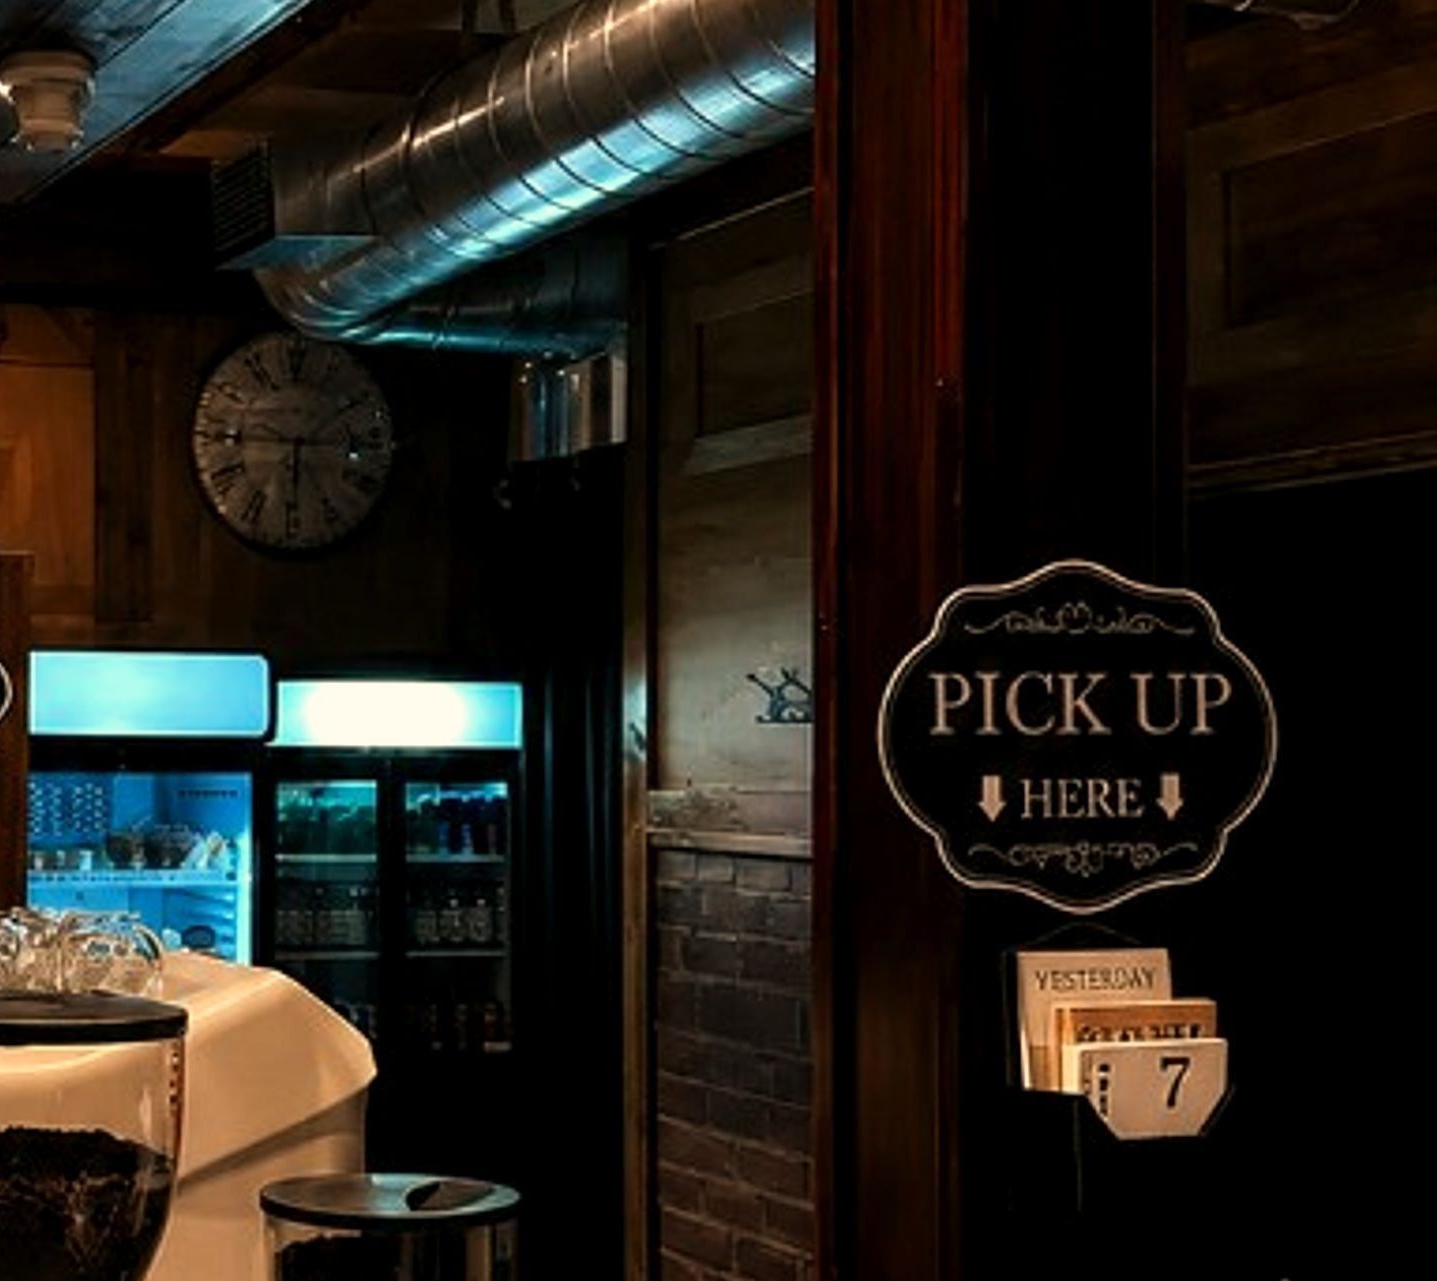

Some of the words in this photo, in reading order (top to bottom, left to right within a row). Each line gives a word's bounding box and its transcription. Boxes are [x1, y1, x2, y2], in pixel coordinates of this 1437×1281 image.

[928, 670, 1113, 736] PICK
[1130, 670, 1233, 736] UP
[1020, 777, 1145, 820] HERE
[1035, 967, 1156, 991] YESTERDAY
[1159, 1056, 1192, 1110] 7
